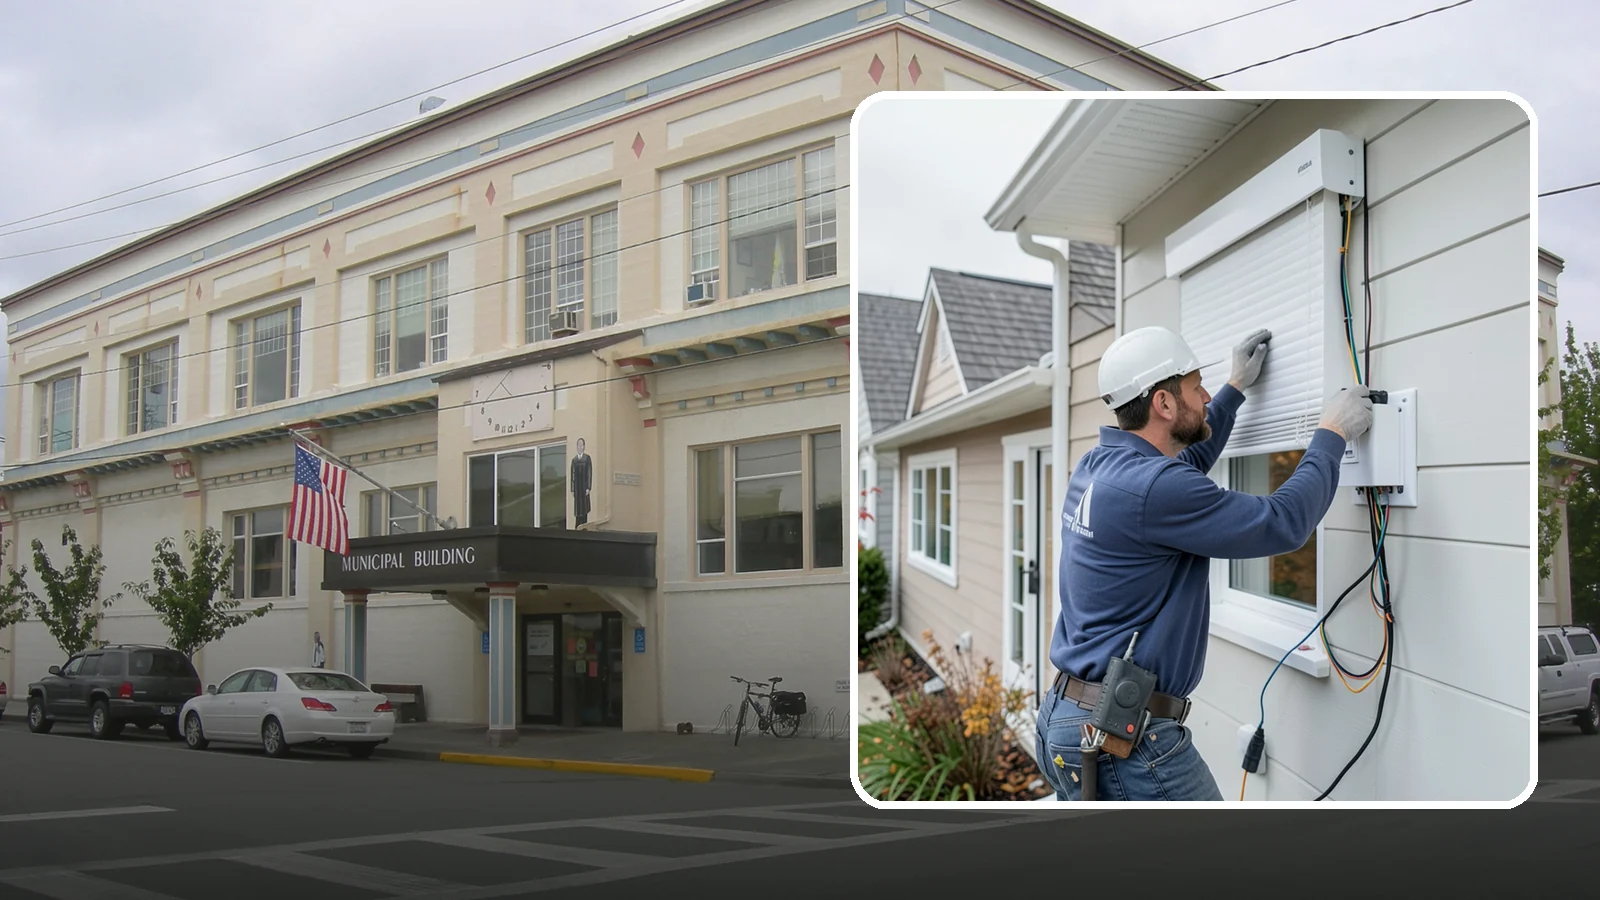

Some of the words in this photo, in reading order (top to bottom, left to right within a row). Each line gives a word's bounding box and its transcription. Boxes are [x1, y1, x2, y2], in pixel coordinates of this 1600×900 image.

[529, 414, 532, 422] 3
[342, 552, 405, 572] MUNICIPAL
[414, 546, 475, 567] BUILDING
